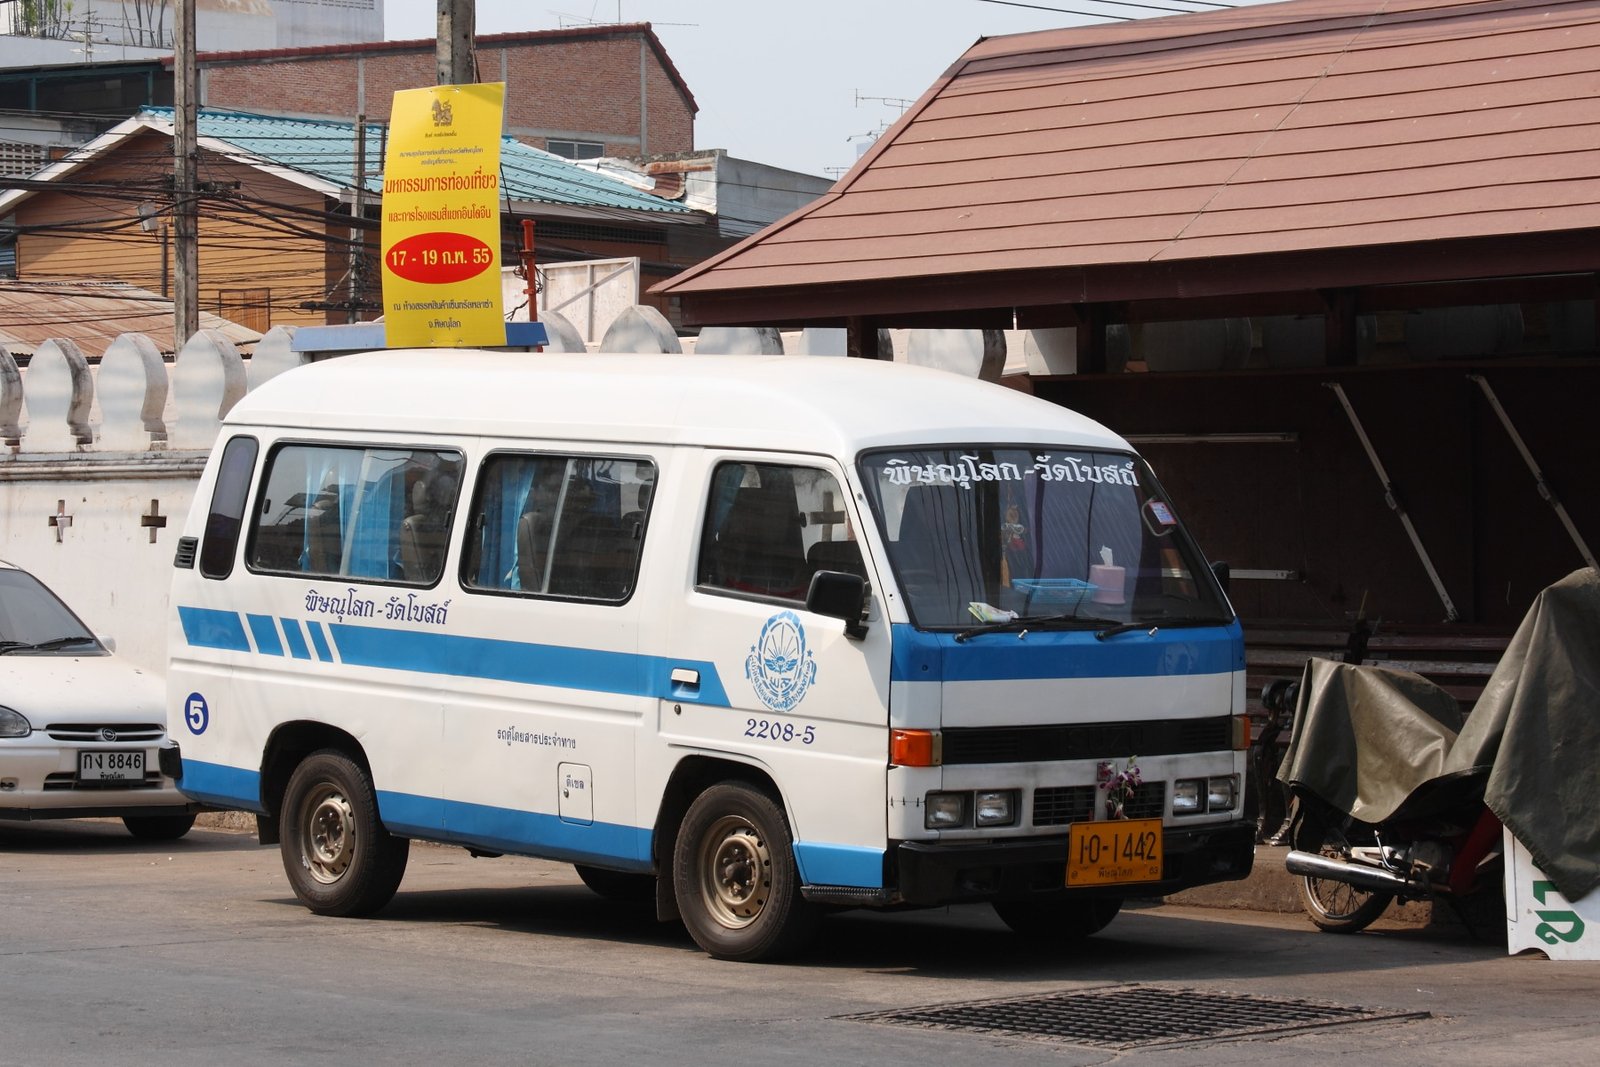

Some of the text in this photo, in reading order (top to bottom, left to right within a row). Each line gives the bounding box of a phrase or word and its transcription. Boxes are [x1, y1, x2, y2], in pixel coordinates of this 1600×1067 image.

[385, 165, 497, 194] มหกรรมการท่องเที่ยว
[388, 204, 491, 223] และการโรงแรมสี่แยกอินโดจีน
[392, 250, 407, 266] 17
[422, 249, 438, 265] 19
[442, 250, 467, 264] ก.พ.
[473, 247, 490, 263] 55
[190, 700, 204, 730] 5
[744, 718, 816, 745] 2208-5
[108, 754, 141, 769] 8846
[1080, 831, 1157, 864] 10-1442
